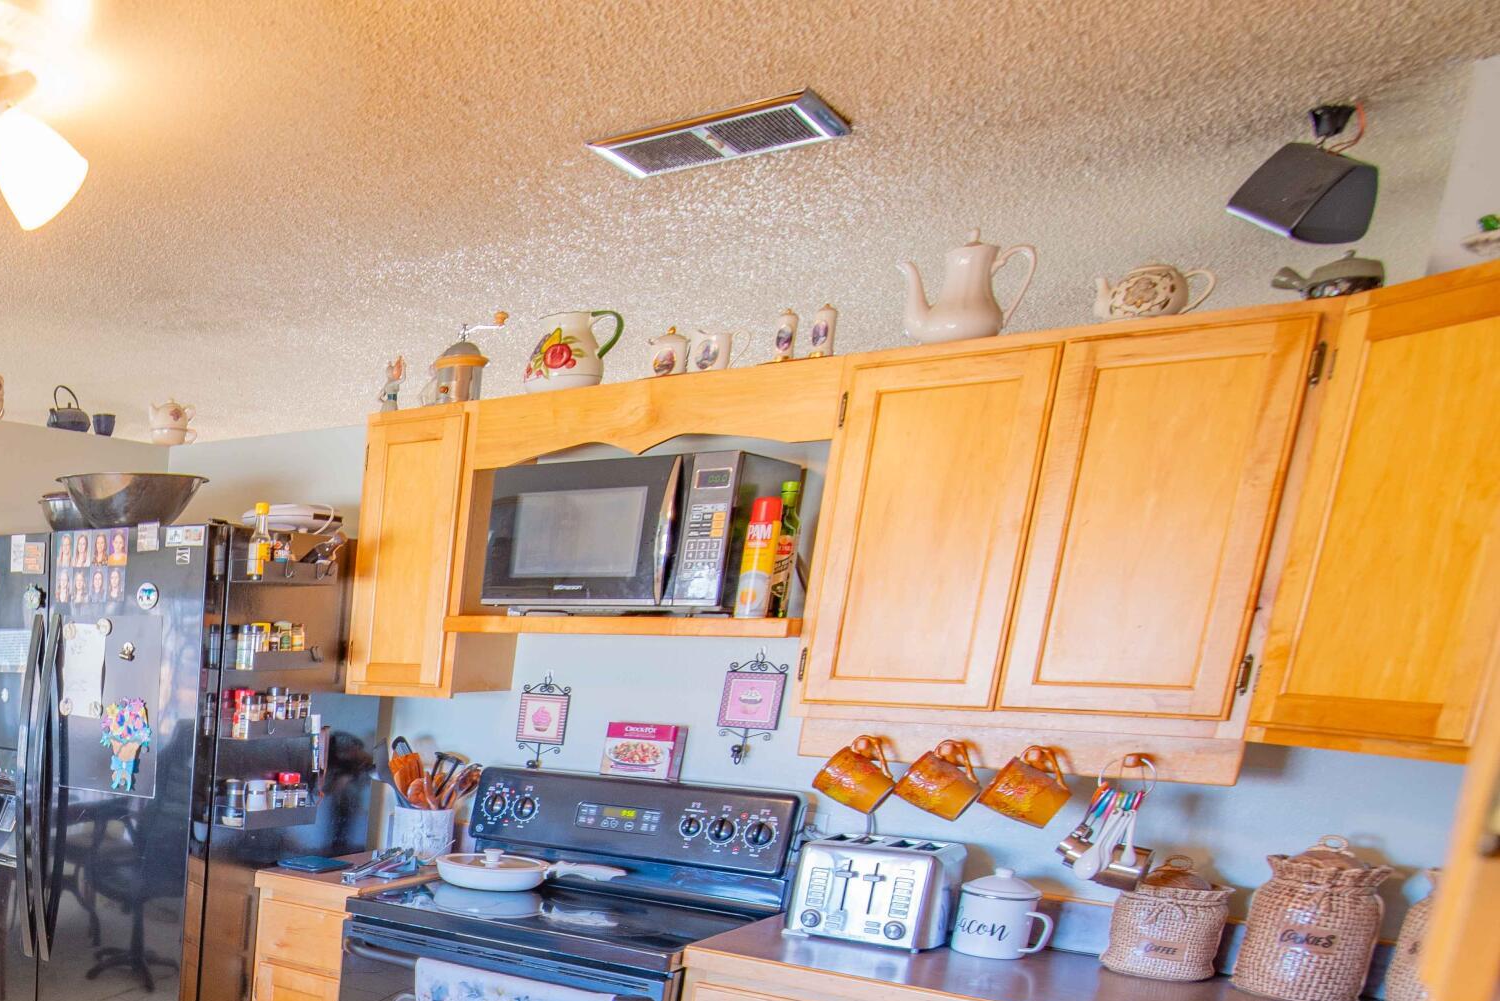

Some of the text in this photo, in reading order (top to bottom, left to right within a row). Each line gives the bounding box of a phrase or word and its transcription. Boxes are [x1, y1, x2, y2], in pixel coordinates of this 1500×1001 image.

[748, 523, 773, 541] PAM
[1279, 929, 1336, 949] COOKIES
[1143, 942, 1179, 955] COFFEE
